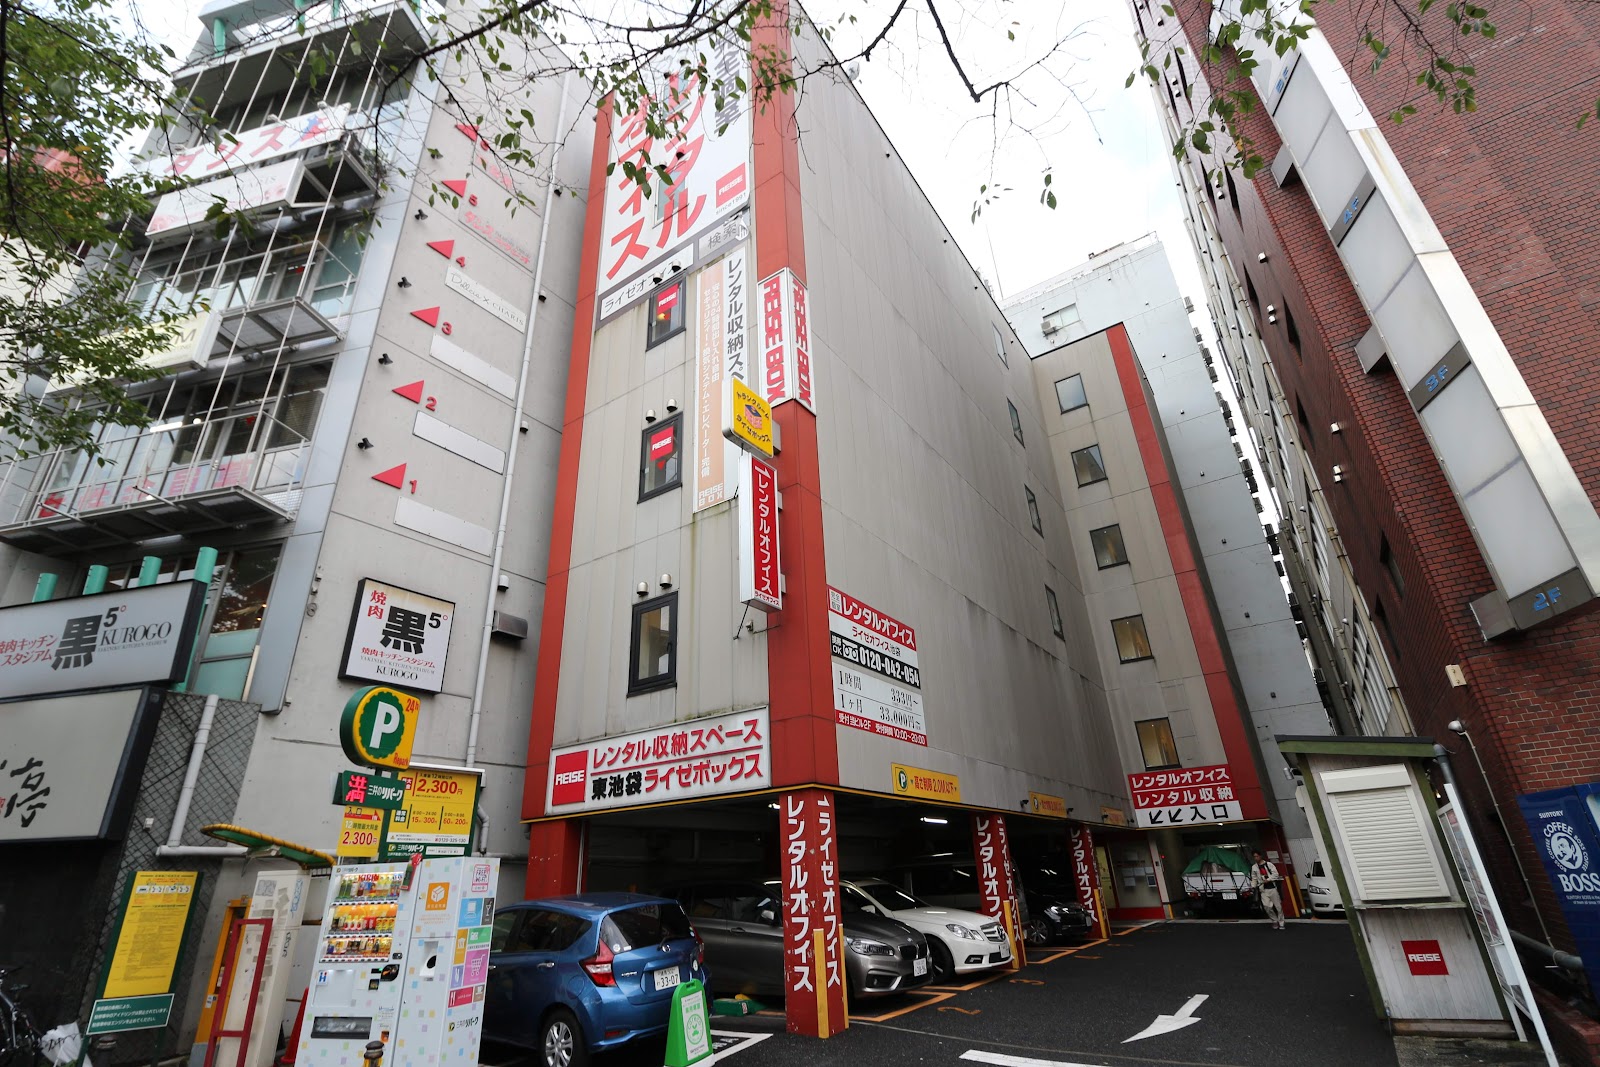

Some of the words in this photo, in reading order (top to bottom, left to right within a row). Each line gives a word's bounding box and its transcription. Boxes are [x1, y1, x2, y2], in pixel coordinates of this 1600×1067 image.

[719, 174, 743, 196] REISE
[469, 194, 478, 206] 5
[1344, 197, 1358, 224] 4F
[708, 223, 738, 249] 検索
[456, 256, 466, 268] 4
[658, 292, 677, 307] REISE
[492, 302, 524, 326] CHARIS
[764, 276, 783, 349] REISE
[793, 278, 808, 352] REISE
[442, 322, 452, 335] 3
[766, 345, 785, 404] BOX
[797, 347, 811, 408] BOX
[1425, 365, 1448, 392] 3F
[426, 396, 437, 411] 2
[652, 436, 671, 450] REISE
[409, 480, 417, 494] 1
[699, 483, 723, 499] REISE
[758, 474, 773, 596] レンタルオフィス
[367, 590, 387, 620] 焼肉
[1533, 587, 1561, 612] 2F
[380, 606, 427, 655] 黒
[843, 597, 915, 648] レンタルオフィス
[51, 615, 103, 671] 黒
[100, 622, 172, 646] KUROGO
[1, 649, 53, 667] スタジアム
[832, 645, 842, 656] OK
[376, 665, 418, 681] KUROGO
[860, 646, 920, 687] 0120-042-054
[405, 698, 420, 714] 24h
[369, 700, 400, 750] P
[593, 718, 763, 769] レンタル収納スペース
[416, 779, 463, 795] 2,300円
[555, 769, 585, 786] REISE
[1132, 767, 1230, 789] レンタルオフィス
[346, 775, 368, 804] 満
[368, 784, 404, 802] 三井のリパーク
[1137, 786, 1234, 808] レンタル収納
[1190, 804, 1229, 821] 入口
[1539, 811, 1564, 819] SUNTORY
[1543, 821, 1574, 839] COFFEE
[976, 816, 1003, 923] レンタルオフィ
[1558, 872, 1600, 893] BOSS
[787, 796, 814, 993] レンタルオフィス
[818, 811, 841, 989] ライゼオフィス
[1408, 953, 1442, 963] REISE
